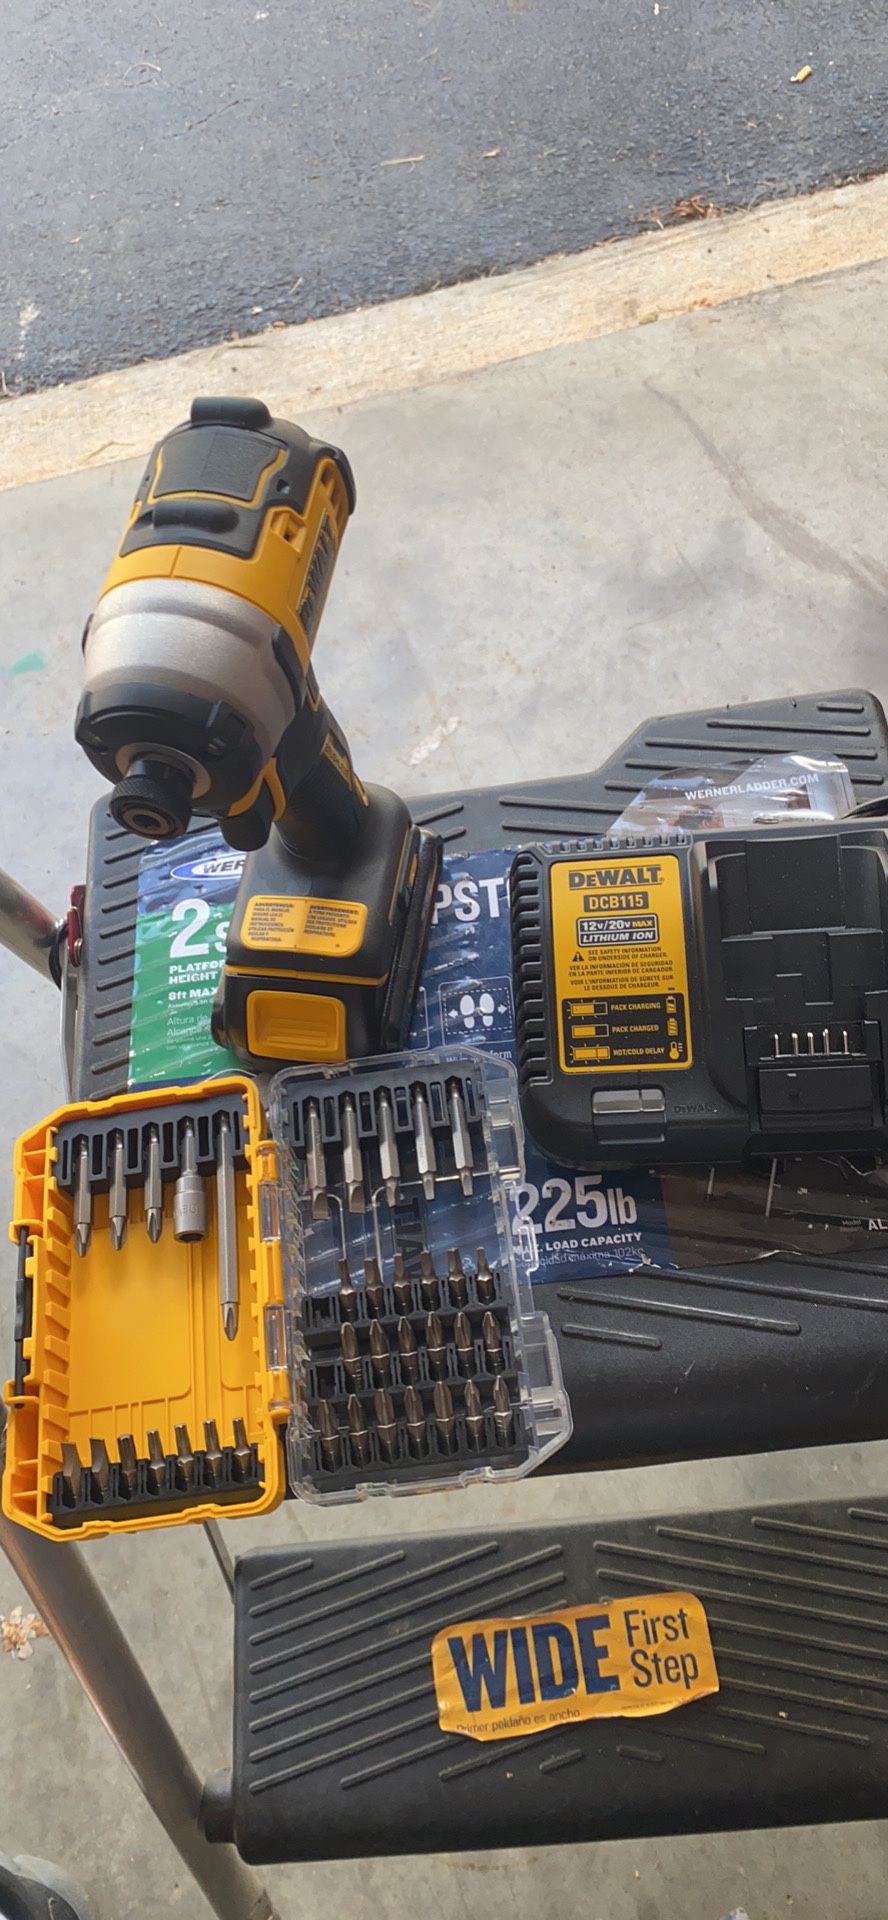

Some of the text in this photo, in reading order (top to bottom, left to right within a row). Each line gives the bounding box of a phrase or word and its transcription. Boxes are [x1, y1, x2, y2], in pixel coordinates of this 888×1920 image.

[685, 773, 820, 801] WERNERLADDER.COM
[568, 866, 662, 890] DEWALT
[432, 878, 510, 924] PST
[589, 894, 644, 910] DCB115
[170, 898, 211, 958] 2
[582, 920, 653, 931] 12v/20v MAX
[582, 931, 654, 943] LITHIUM ION
[622, 946, 662, 954] INFORMATION
[590, 961, 630, 970] INFORMACIÓN
[169, 971, 218, 985] HEIGHT
[168, 987, 218, 1001] 8ft MAX
[628, 1002, 661, 1010] CHARGING
[167, 1016, 194, 1026] Altura
[629, 1024, 660, 1032] CHARGED
[613, 1047, 665, 1056] HOT/COLD DELAY
[512, 1174, 637, 1236] 225lb
[513, 1232, 642, 1255] MA. LOAD CAPACITY
[447, 1608, 689, 1713] WIDE First
[630, 1649, 699, 1690] Step
[534, 1712, 547, 1723] es
[549, 1708, 580, 1722] ancho
